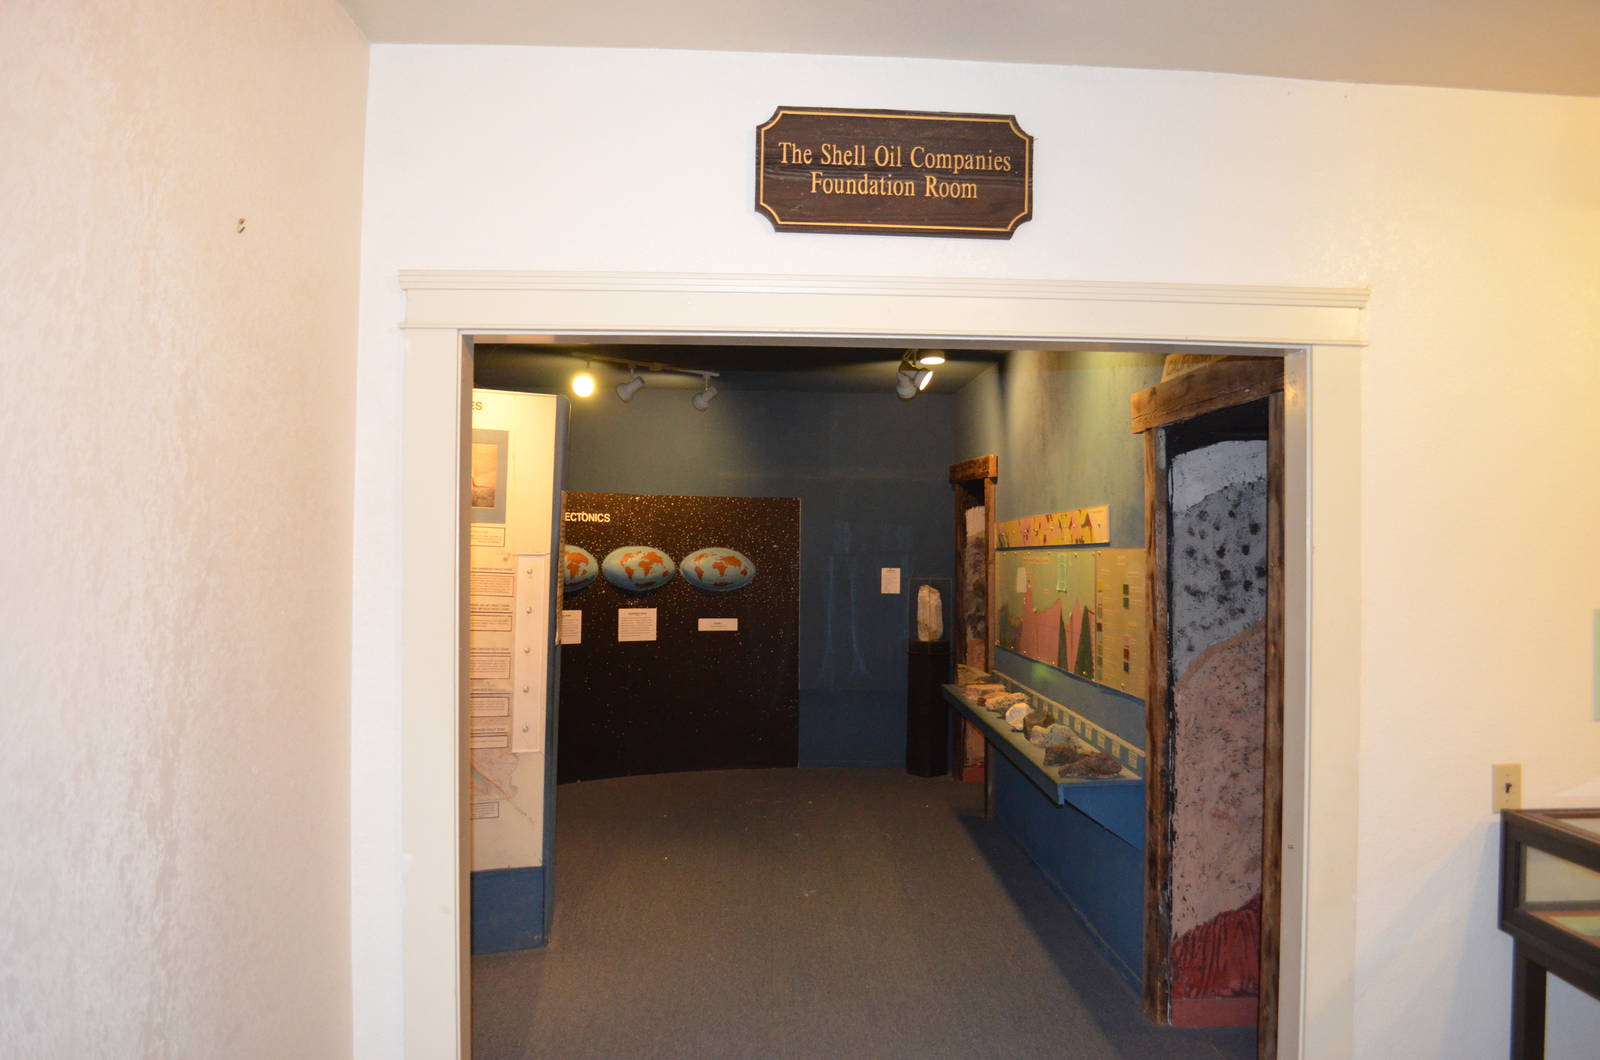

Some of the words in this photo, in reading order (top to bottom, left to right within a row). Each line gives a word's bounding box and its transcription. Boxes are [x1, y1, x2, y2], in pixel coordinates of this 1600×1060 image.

[778, 142, 813, 165] The
[820, 143, 866, 167] Shell
[874, 144, 902, 168] Oil
[910, 146, 1012, 174] Companies
[810, 171, 916, 197] Foundation
[924, 175, 978, 199] Room
[564, 512, 611, 523] ECTONICS
